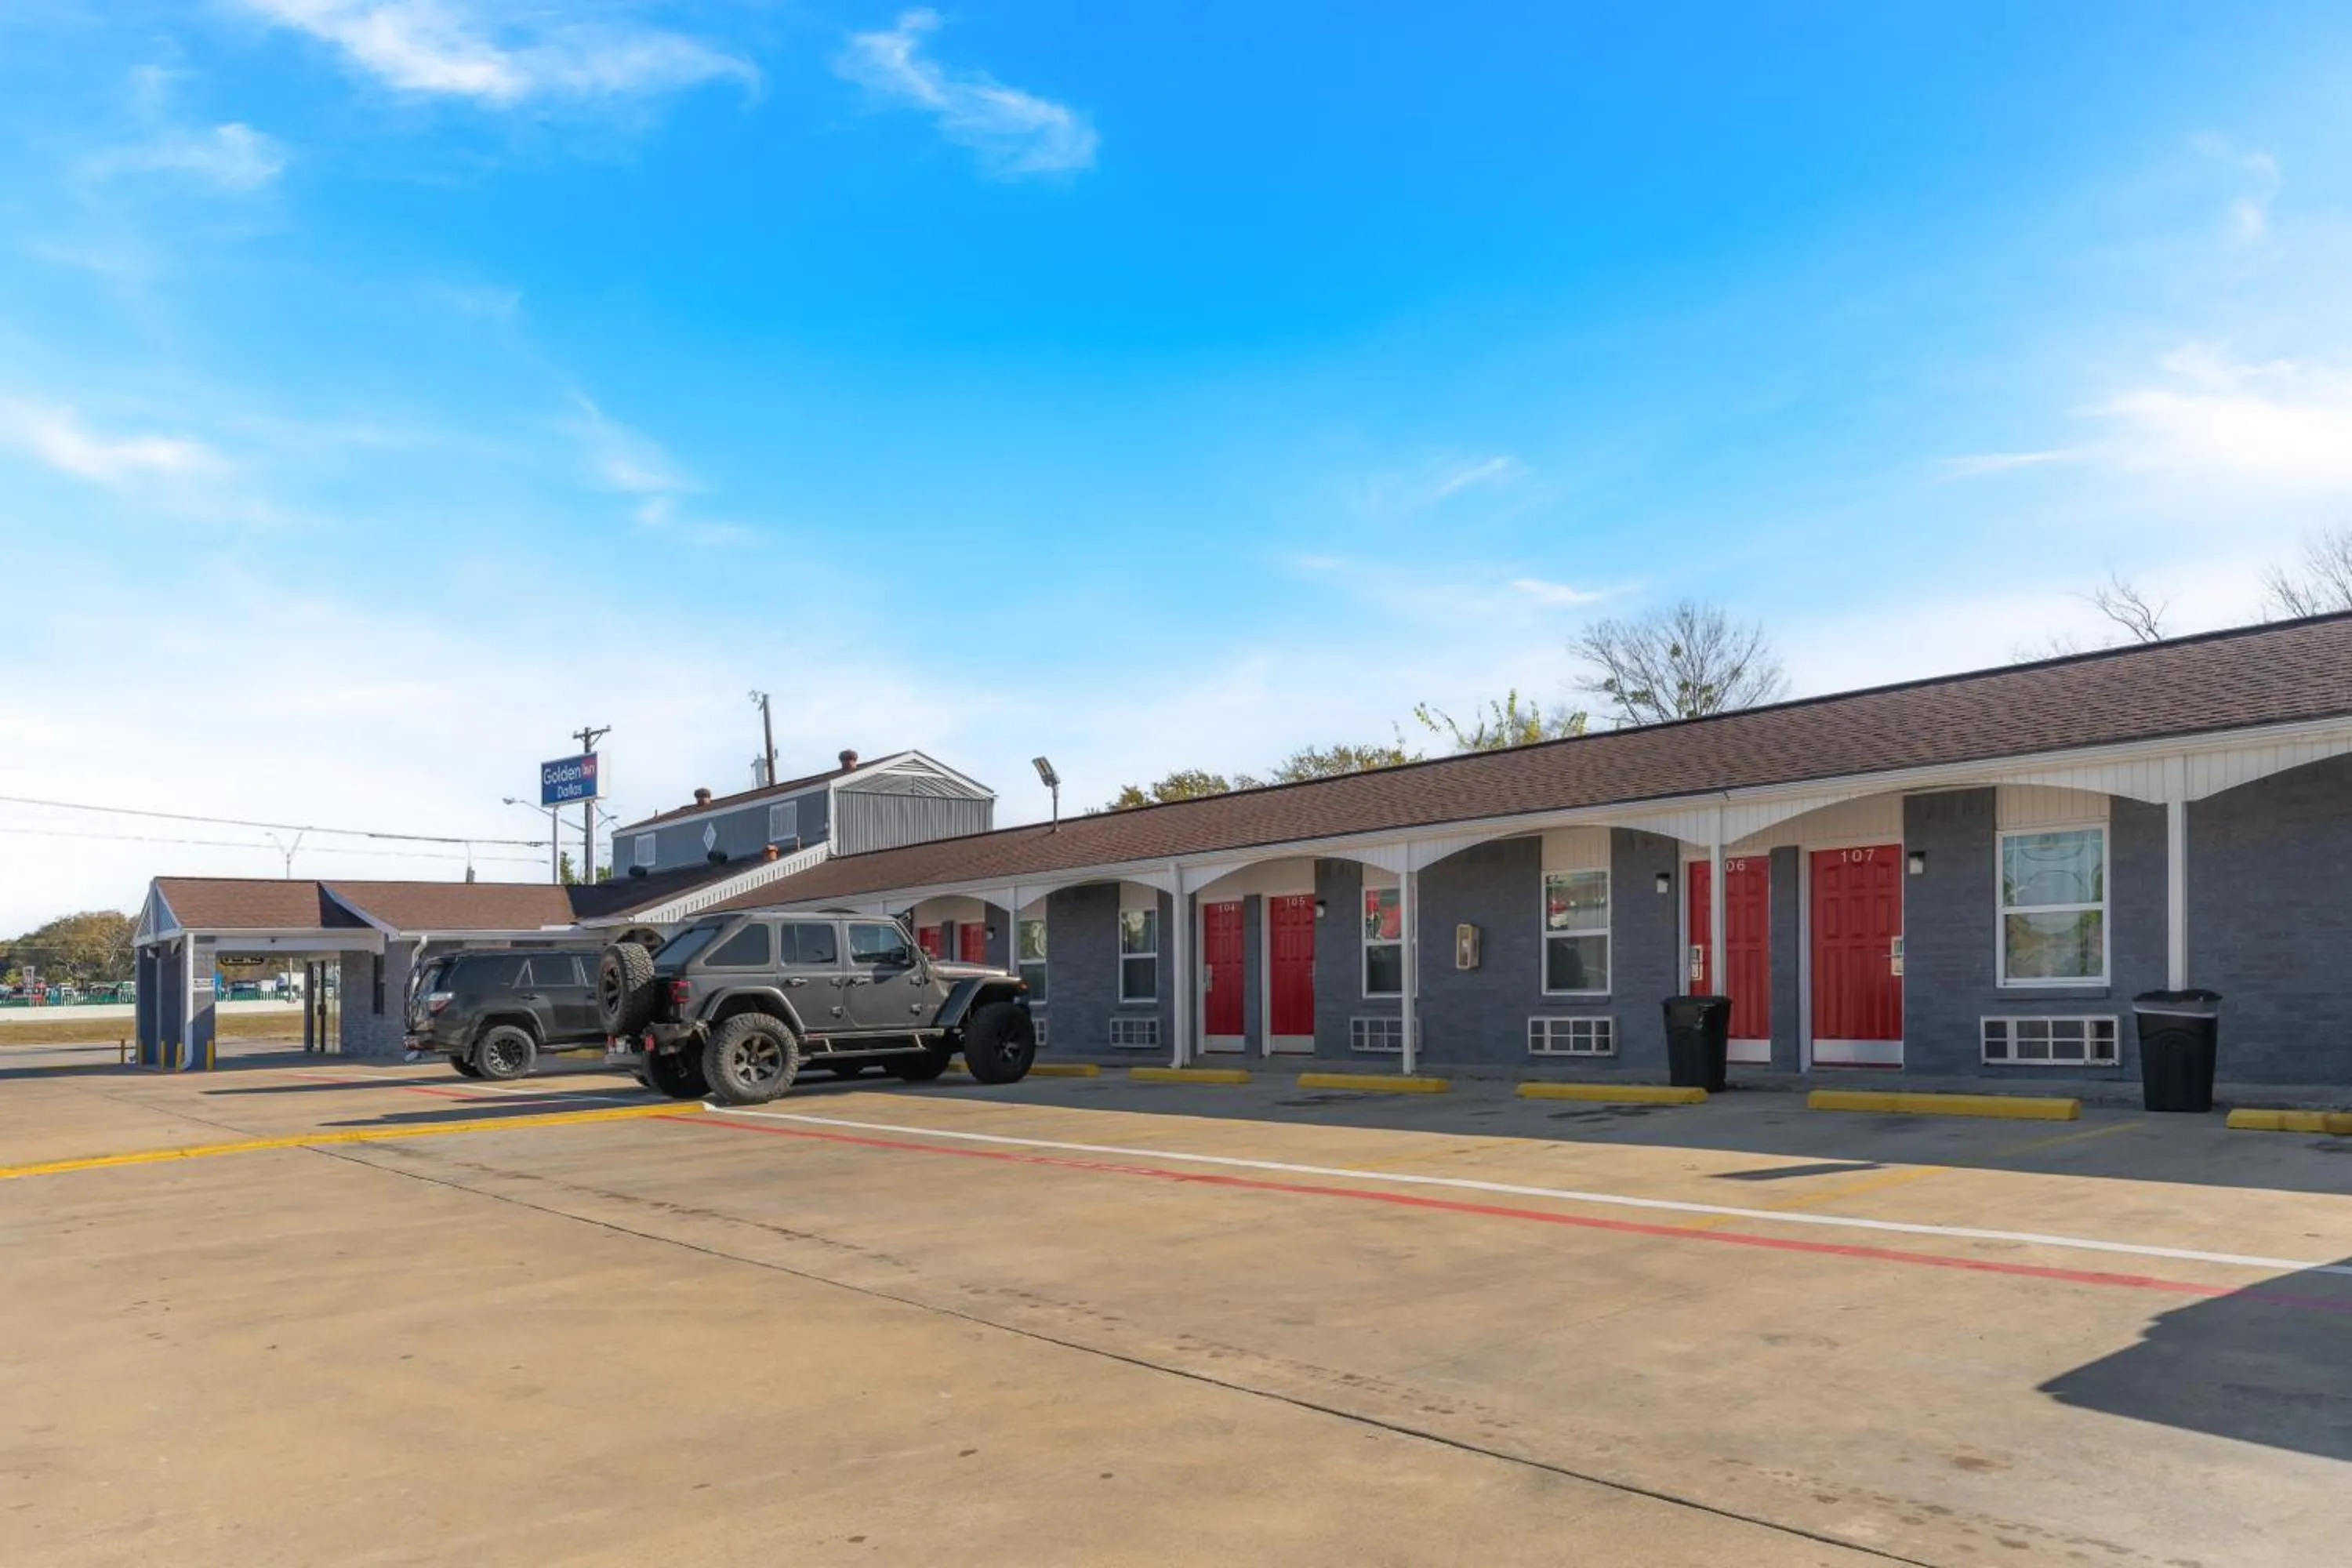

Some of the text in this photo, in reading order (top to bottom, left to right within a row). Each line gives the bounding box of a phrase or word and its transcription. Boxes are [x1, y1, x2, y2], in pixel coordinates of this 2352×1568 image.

[543, 765, 581, 785] Golden
[1841, 848, 1875, 863] 107
[1726, 859, 1746, 873] 06
[1287, 896, 1306, 908] 105
